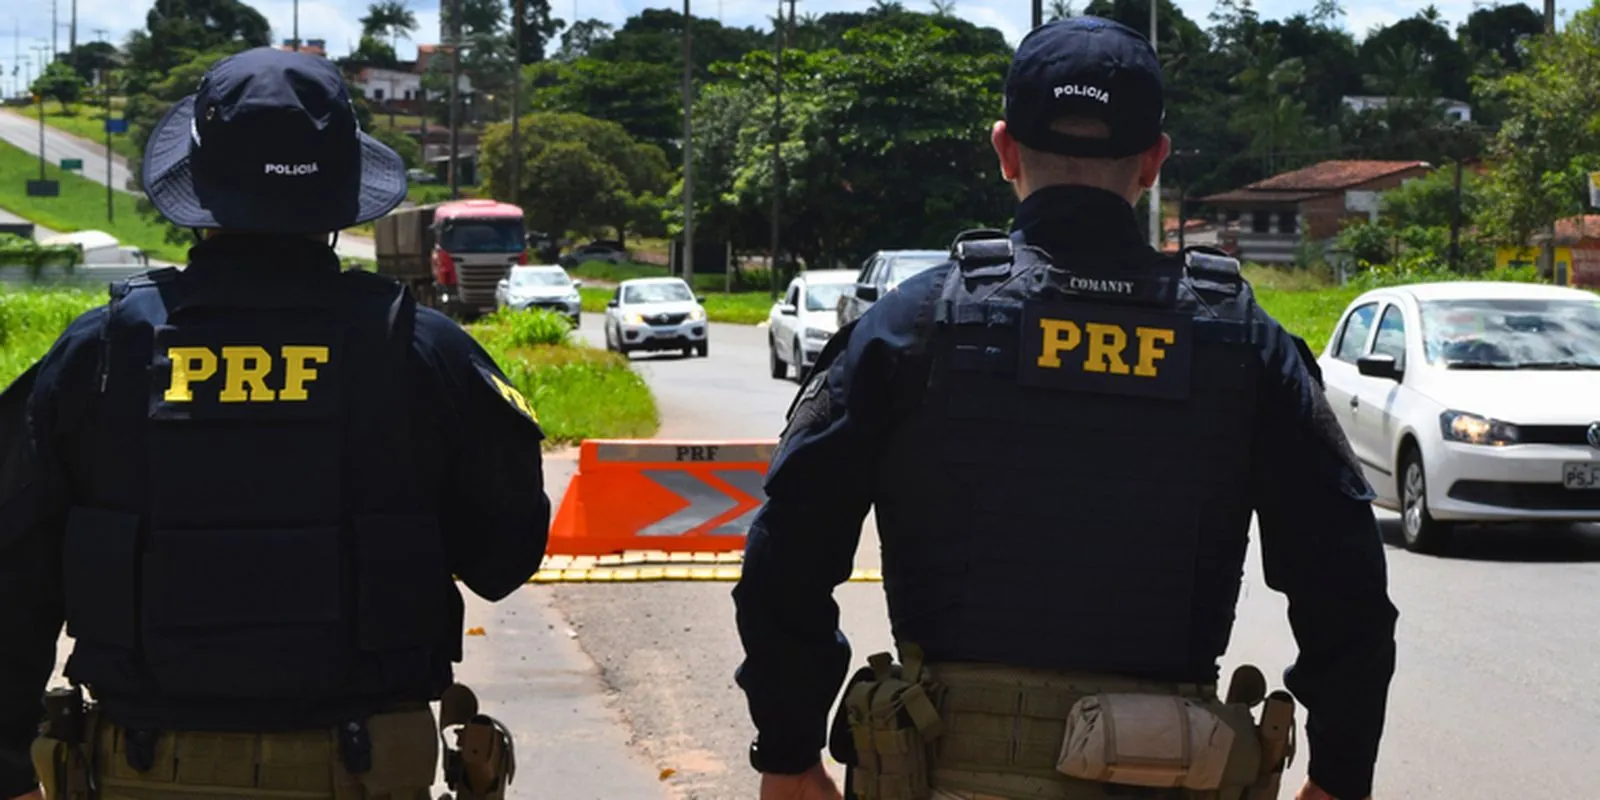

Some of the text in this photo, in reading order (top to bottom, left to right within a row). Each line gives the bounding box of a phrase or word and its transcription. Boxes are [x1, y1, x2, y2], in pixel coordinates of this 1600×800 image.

[164, 345, 329, 402] PRF
[1037, 318, 1175, 377] PRF
[675, 445, 719, 462] PRF
